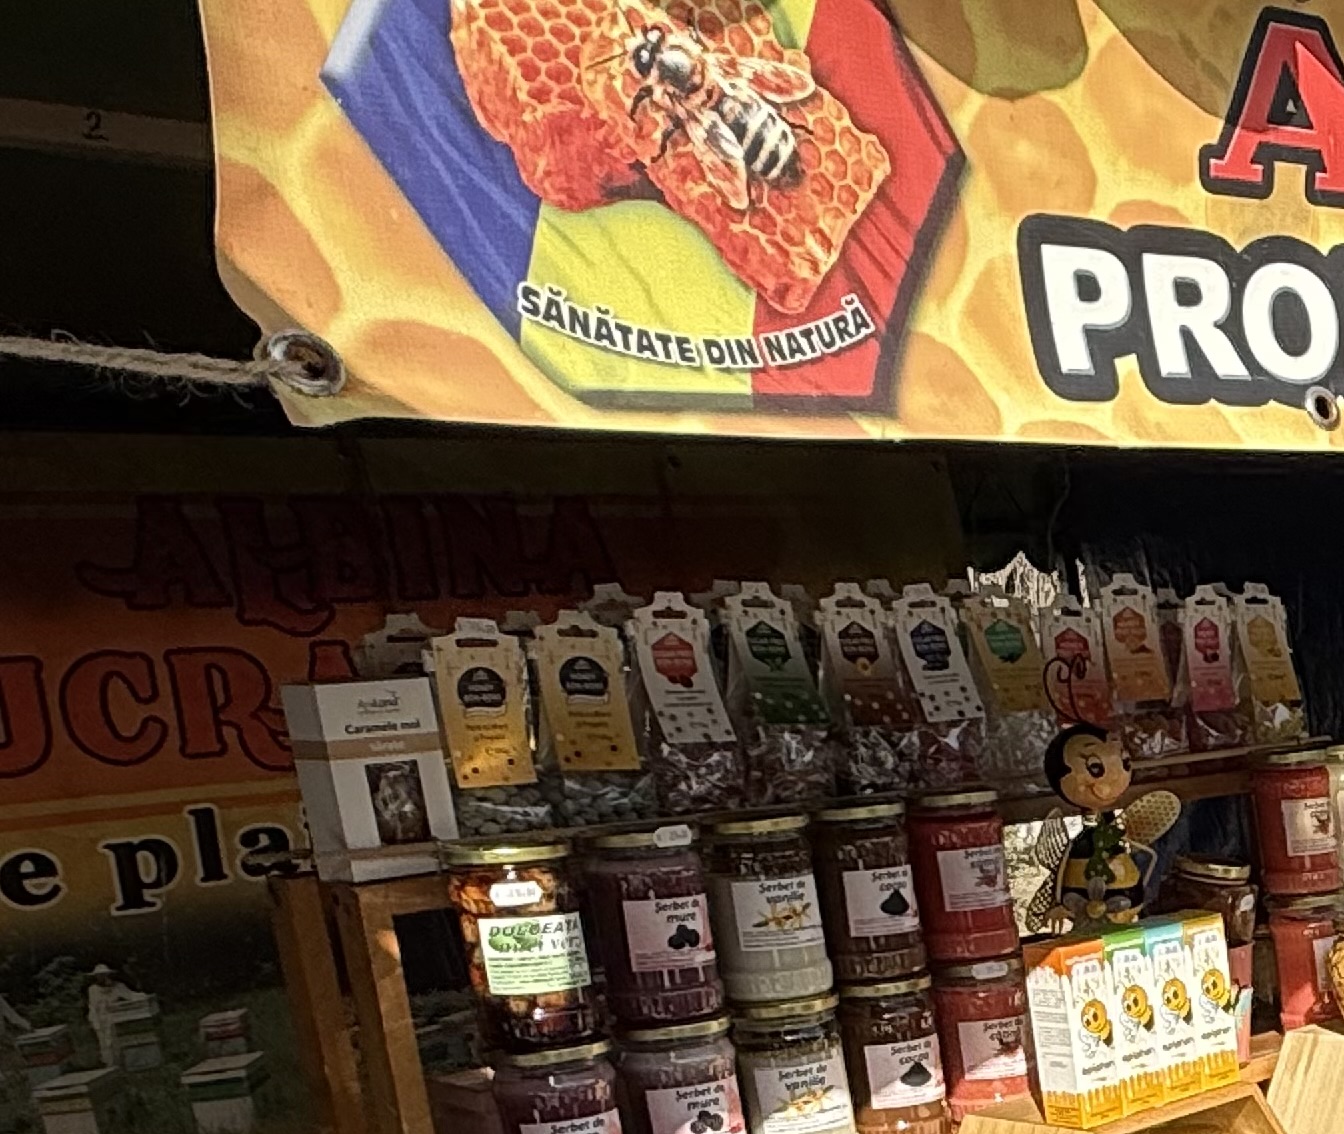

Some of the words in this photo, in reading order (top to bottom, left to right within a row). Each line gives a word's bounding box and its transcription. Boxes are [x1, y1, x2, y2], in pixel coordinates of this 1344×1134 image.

[518, 284, 697, 367] SĂNĂTATE
[705, 336, 761, 368] DIN
[763, 294, 873, 366] NATURĂ
